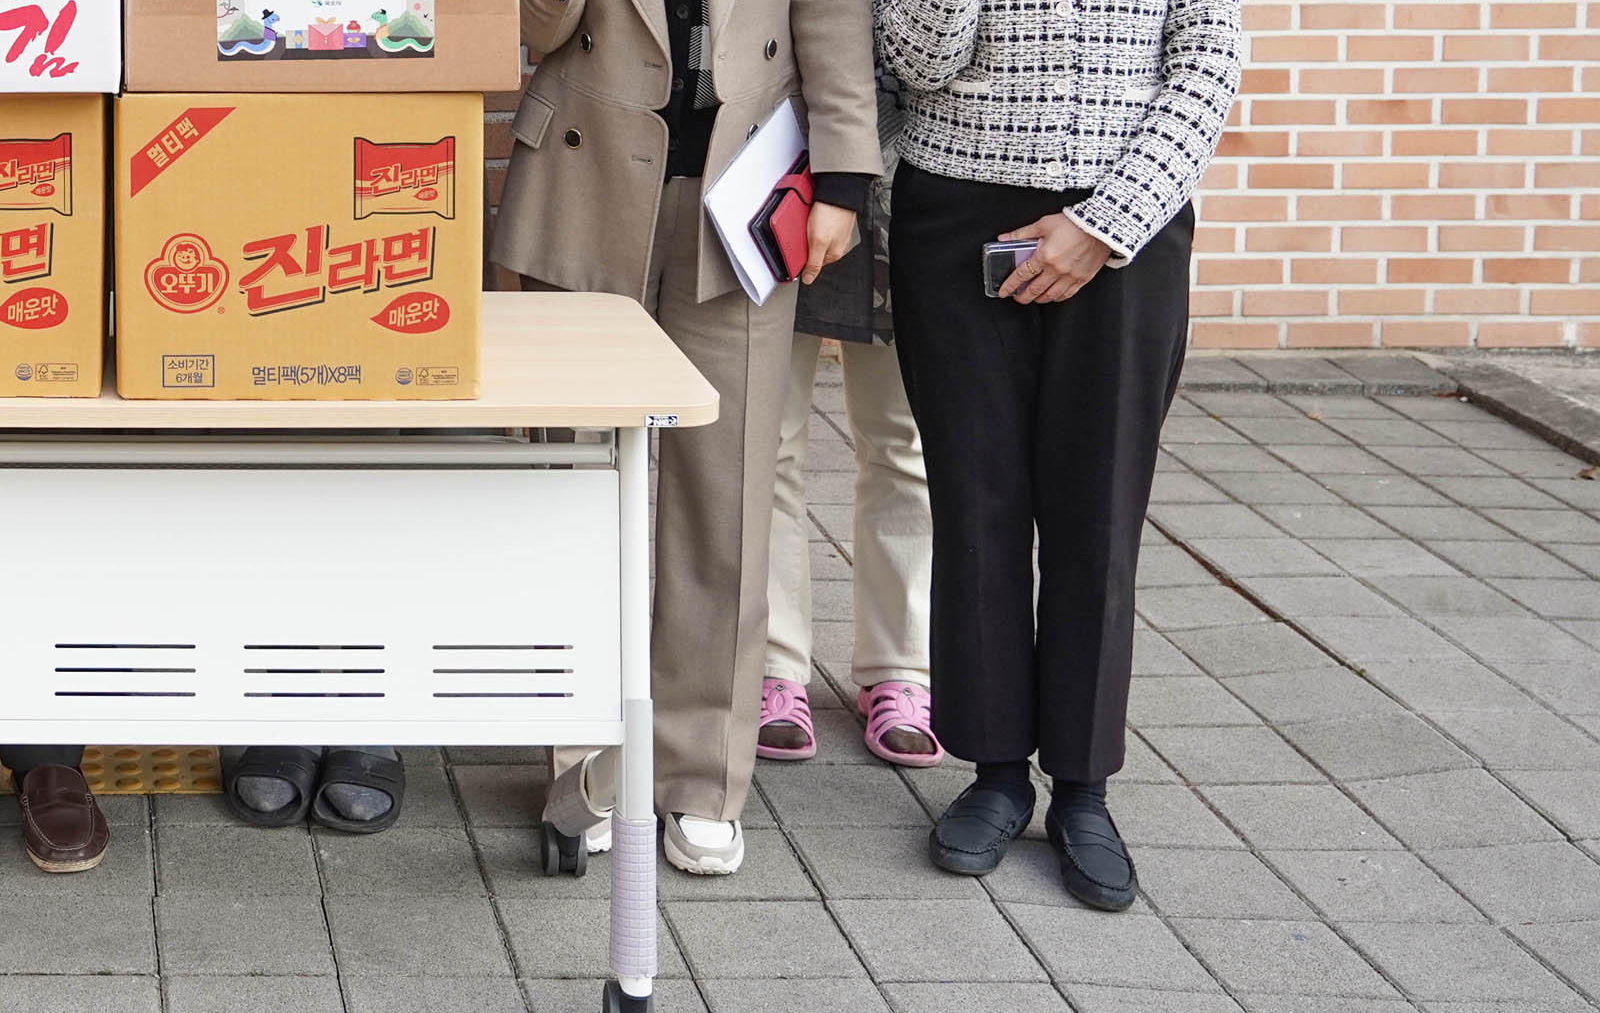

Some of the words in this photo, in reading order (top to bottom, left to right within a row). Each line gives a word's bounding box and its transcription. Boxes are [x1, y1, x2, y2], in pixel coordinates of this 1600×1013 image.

[146, 116, 200, 169] 멀티팩
[369, 163, 439, 197] 진라면
[160, 273, 214, 294] 오뚜기
[238, 224, 436, 317] 진라면
[7, 294, 59, 323] 매운맛
[388, 298, 440, 327] 매운맛
[167, 358, 210, 371] 소비기간
[176, 372, 203, 384] 6개월
[252, 365, 362, 386] 멀티팩(5개)X8팩
